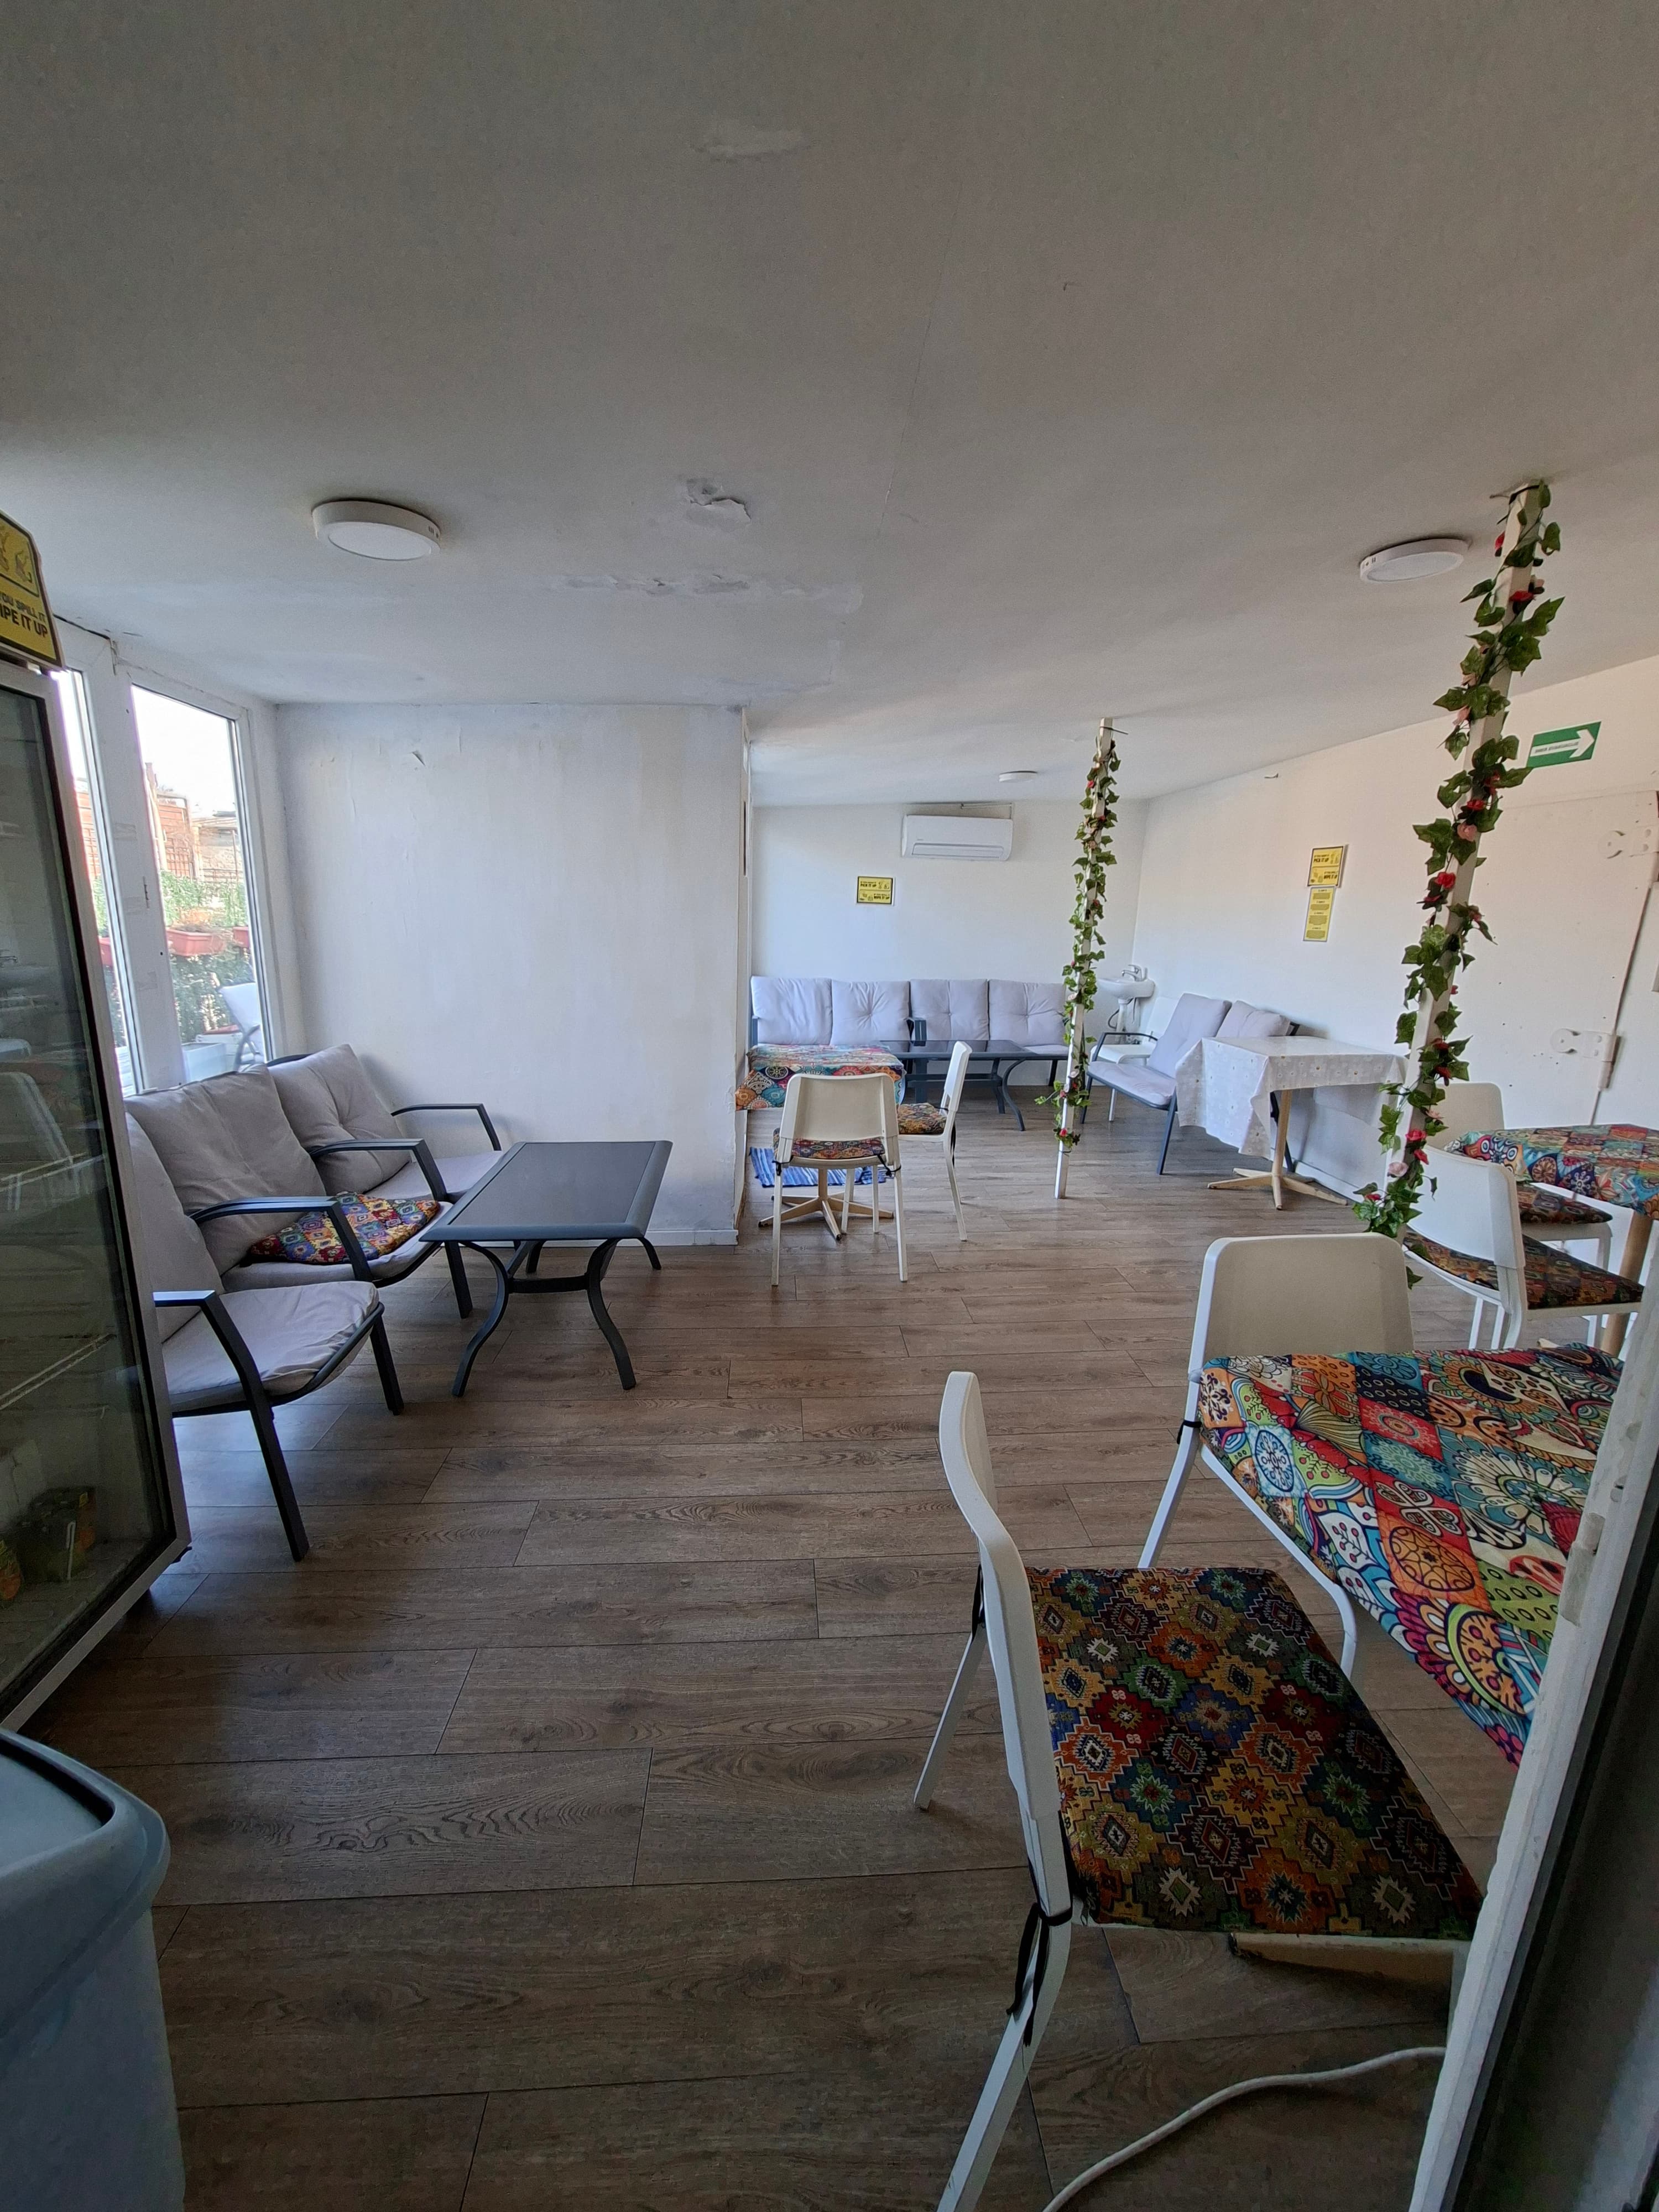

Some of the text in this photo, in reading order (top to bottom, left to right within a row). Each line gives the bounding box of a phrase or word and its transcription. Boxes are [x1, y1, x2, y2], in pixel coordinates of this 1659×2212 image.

[0, 603, 48, 638] IPE IT UP
[38, 611, 45, 623] IT
